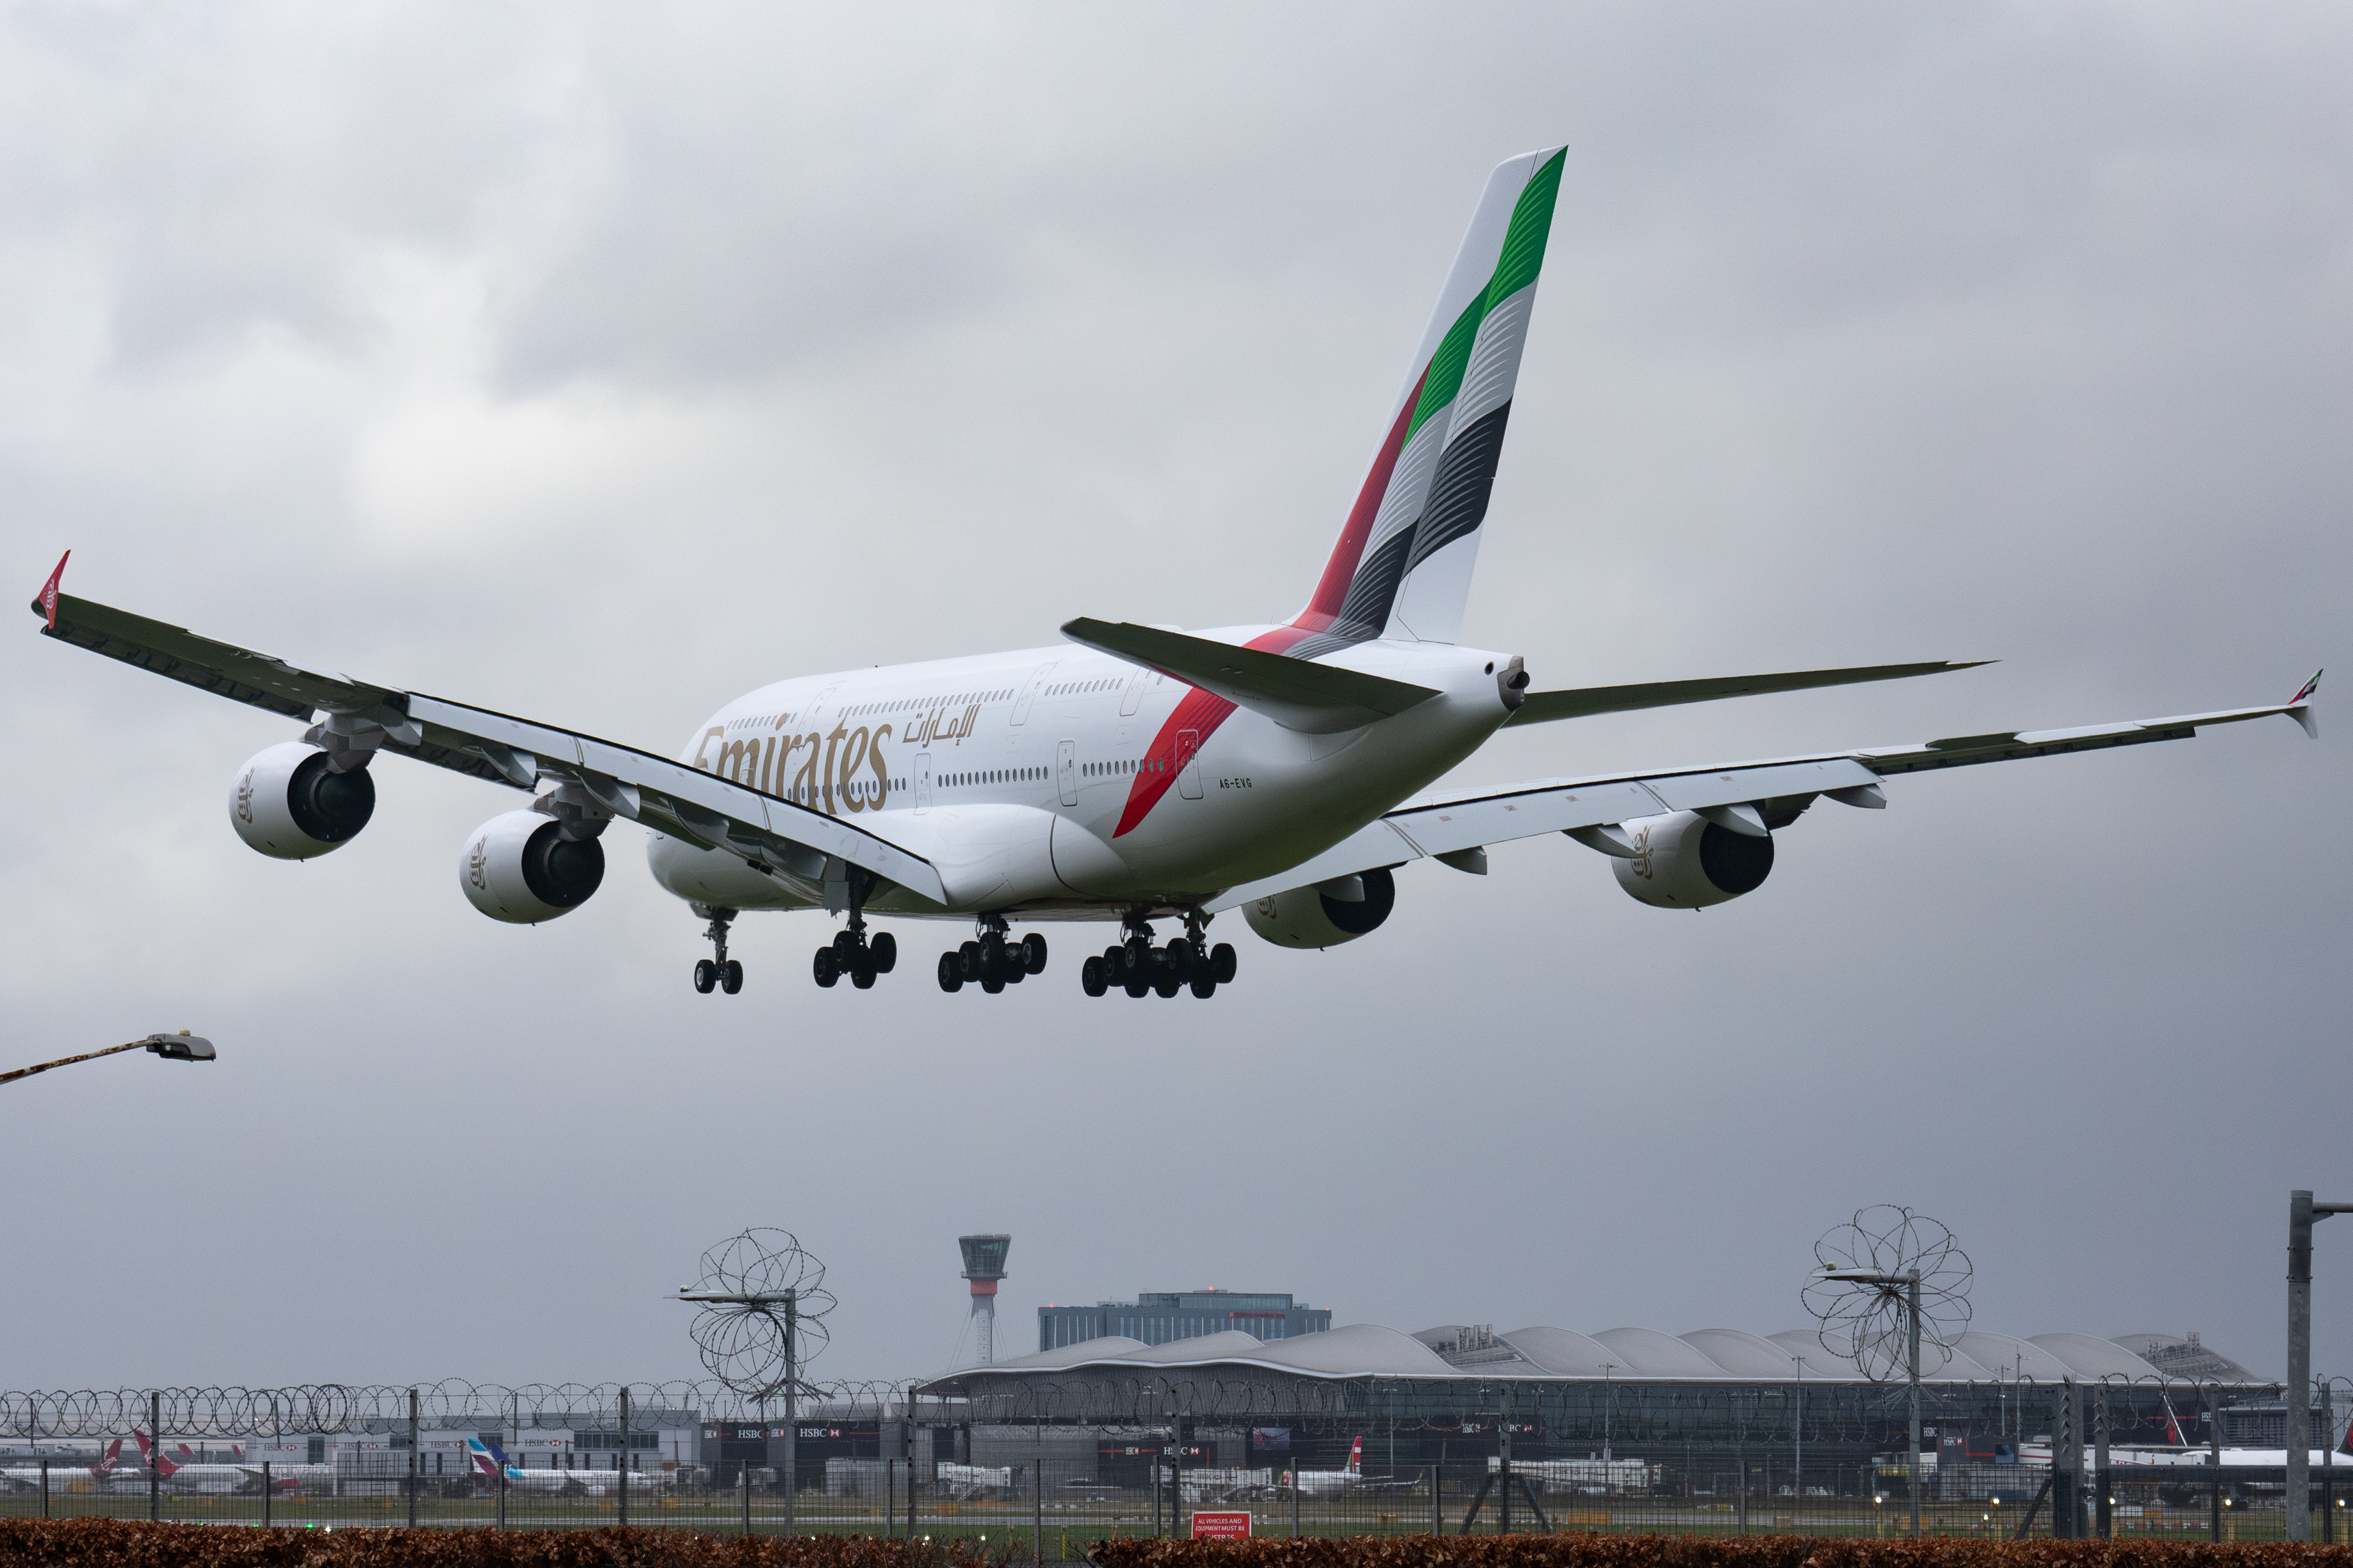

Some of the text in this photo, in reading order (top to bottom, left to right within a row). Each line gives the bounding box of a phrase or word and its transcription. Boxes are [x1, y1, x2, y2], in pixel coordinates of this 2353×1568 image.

[902, 704, 982, 748] الإمارات
[693, 713, 893, 815] Emirates
[1220, 778, 1252, 789] A6-EVG
[738, 1430, 763, 1439] HSBC
[800, 1428, 827, 1437] HSBC
